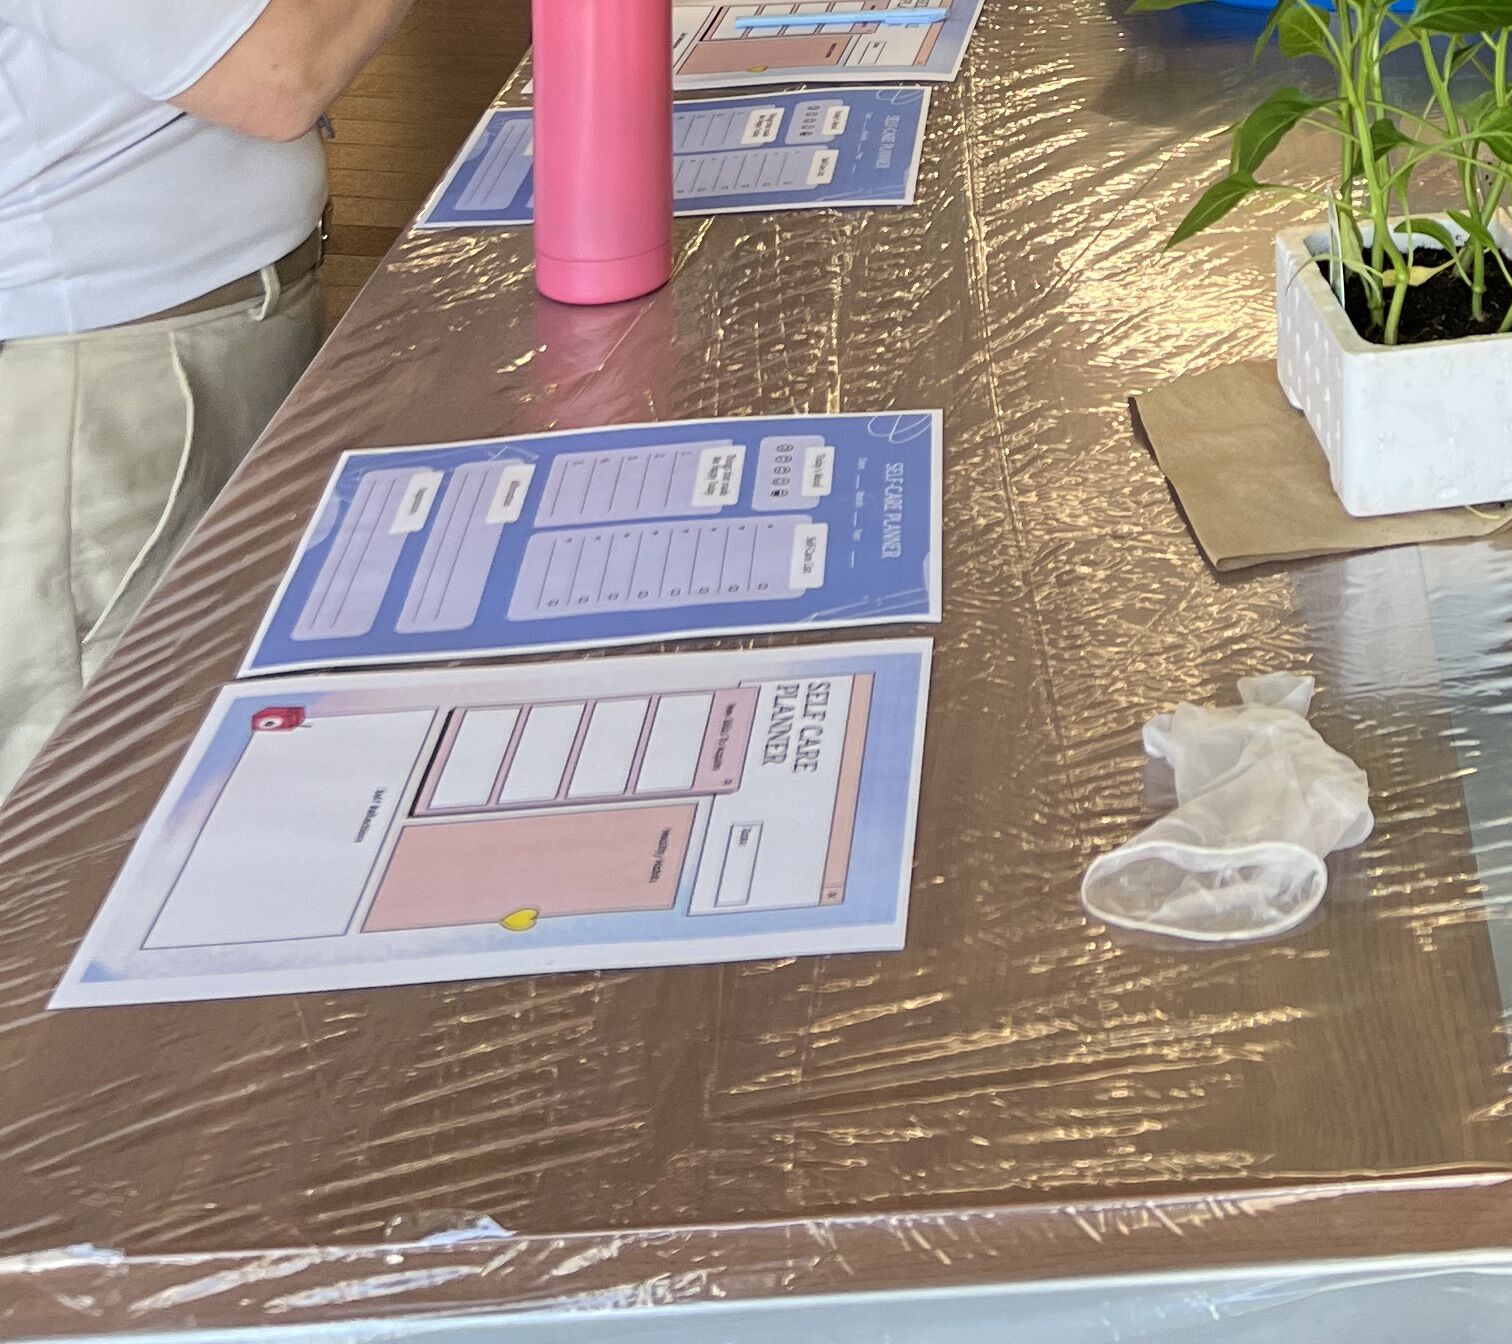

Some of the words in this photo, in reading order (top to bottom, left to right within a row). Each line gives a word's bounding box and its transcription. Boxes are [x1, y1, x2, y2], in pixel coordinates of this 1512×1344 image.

[884, 462, 904, 512] SELF-CARE
[881, 513, 903, 559] PLANNER
[762, 683, 800, 766] PLANNER
[802, 681, 831, 722] SELF
[793, 724, 823, 773] CARE
